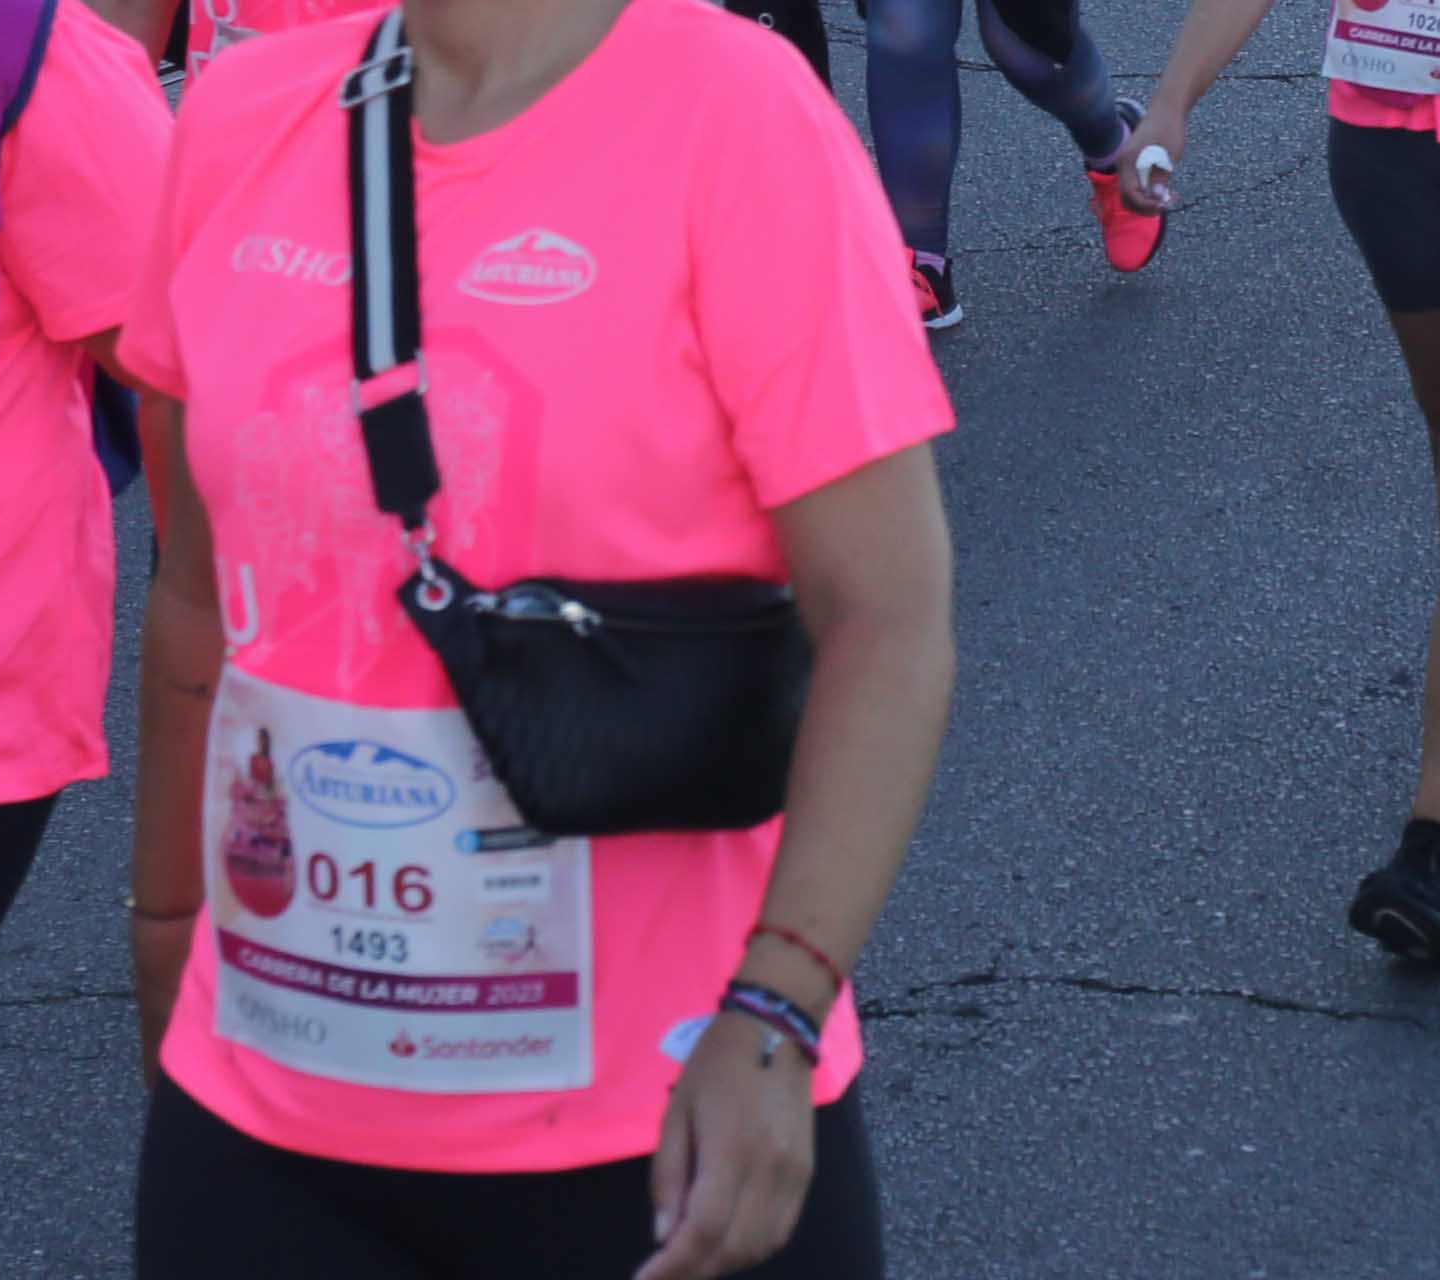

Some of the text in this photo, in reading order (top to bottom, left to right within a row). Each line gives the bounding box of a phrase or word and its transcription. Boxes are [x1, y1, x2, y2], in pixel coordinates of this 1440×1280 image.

[1342, 50, 1396, 75] OYSHO
[302, 762, 441, 809] ASTURIANA
[307, 852, 435, 914] 016
[329, 926, 409, 964] 1493
[238, 946, 324, 988] CARRERA
[326, 971, 356, 997] DE
[360, 978, 391, 1000] LA
[394, 983, 481, 1007] MUJER
[421, 1034, 556, 1060] Santander
